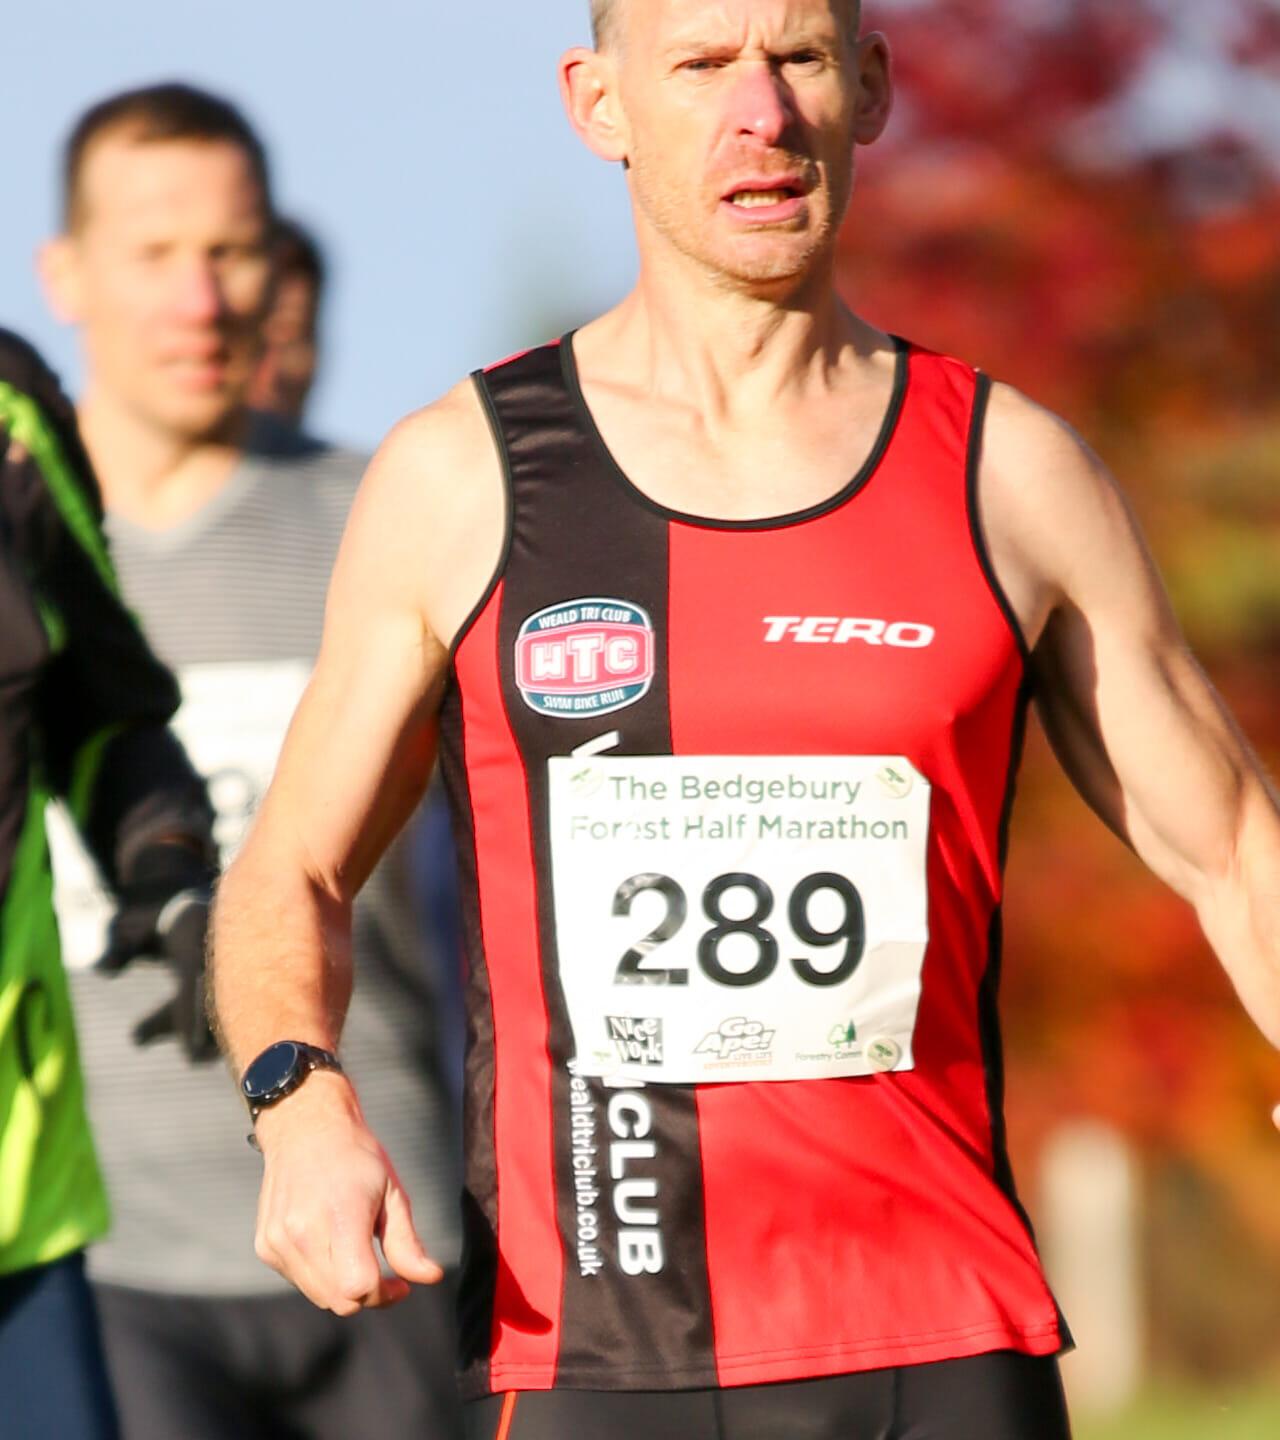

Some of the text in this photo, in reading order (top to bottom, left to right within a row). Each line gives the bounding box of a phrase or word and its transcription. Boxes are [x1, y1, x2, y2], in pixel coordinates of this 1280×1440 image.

[538, 606, 632, 629] WEALD TRI CLUB
[762, 616, 935, 648] TERO
[531, 633, 639, 683] WTC
[543, 688, 625, 710] SWIM BIKE RUN
[609, 774, 862, 805] The Bedgebury
[684, 814, 747, 840] Half
[758, 814, 909, 840] Marathon
[612, 872, 866, 987] 289
[718, 1016, 764, 1038] Go
[607, 1091, 664, 1275] CLUB
